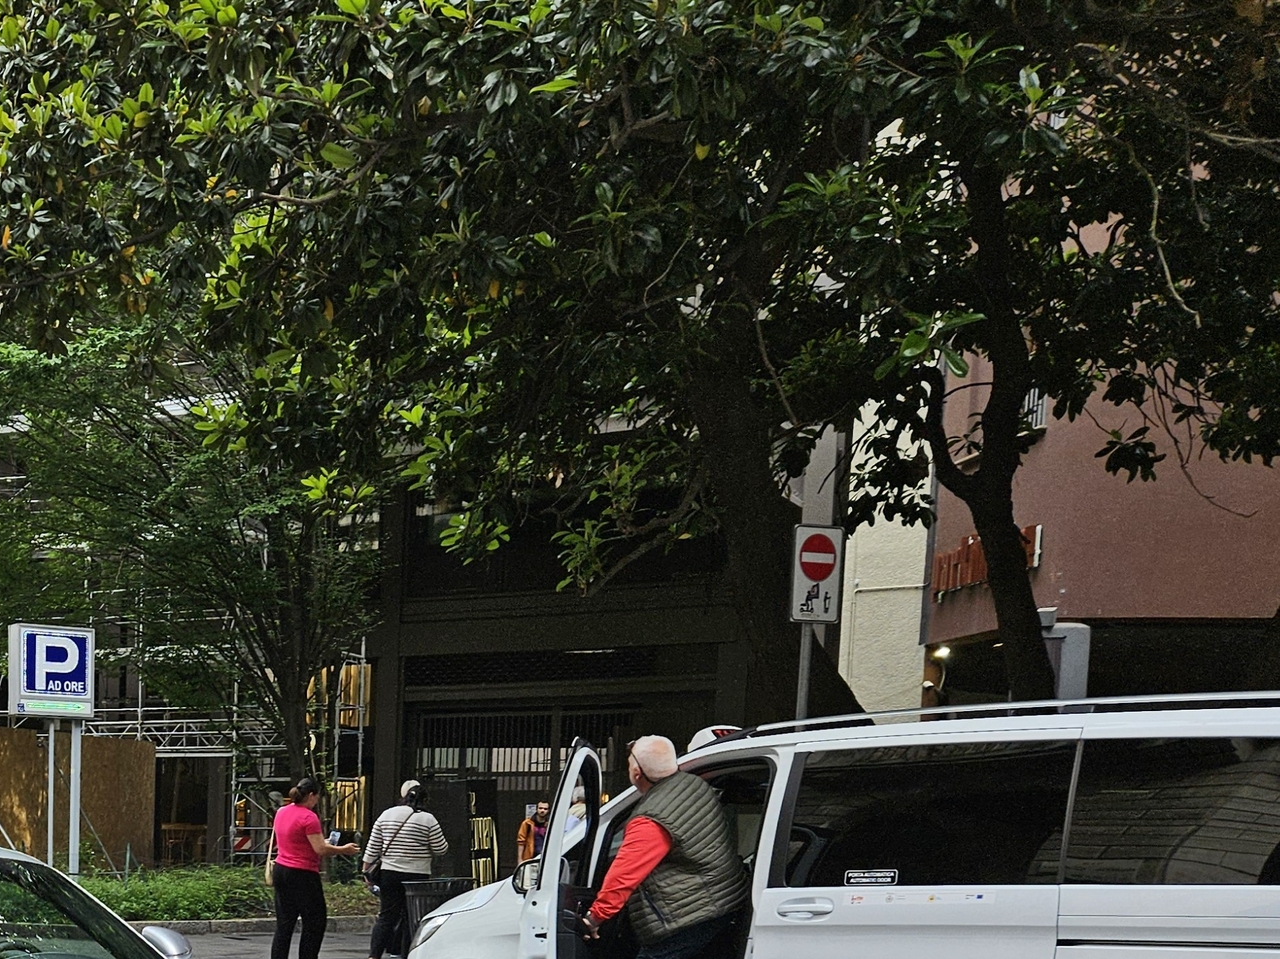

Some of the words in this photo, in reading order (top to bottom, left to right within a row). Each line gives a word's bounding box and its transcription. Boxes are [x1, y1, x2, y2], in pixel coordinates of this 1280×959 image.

[35, 635, 80, 690] P
[47, 680, 62, 691] AD
[63, 681, 85, 692] ORE
